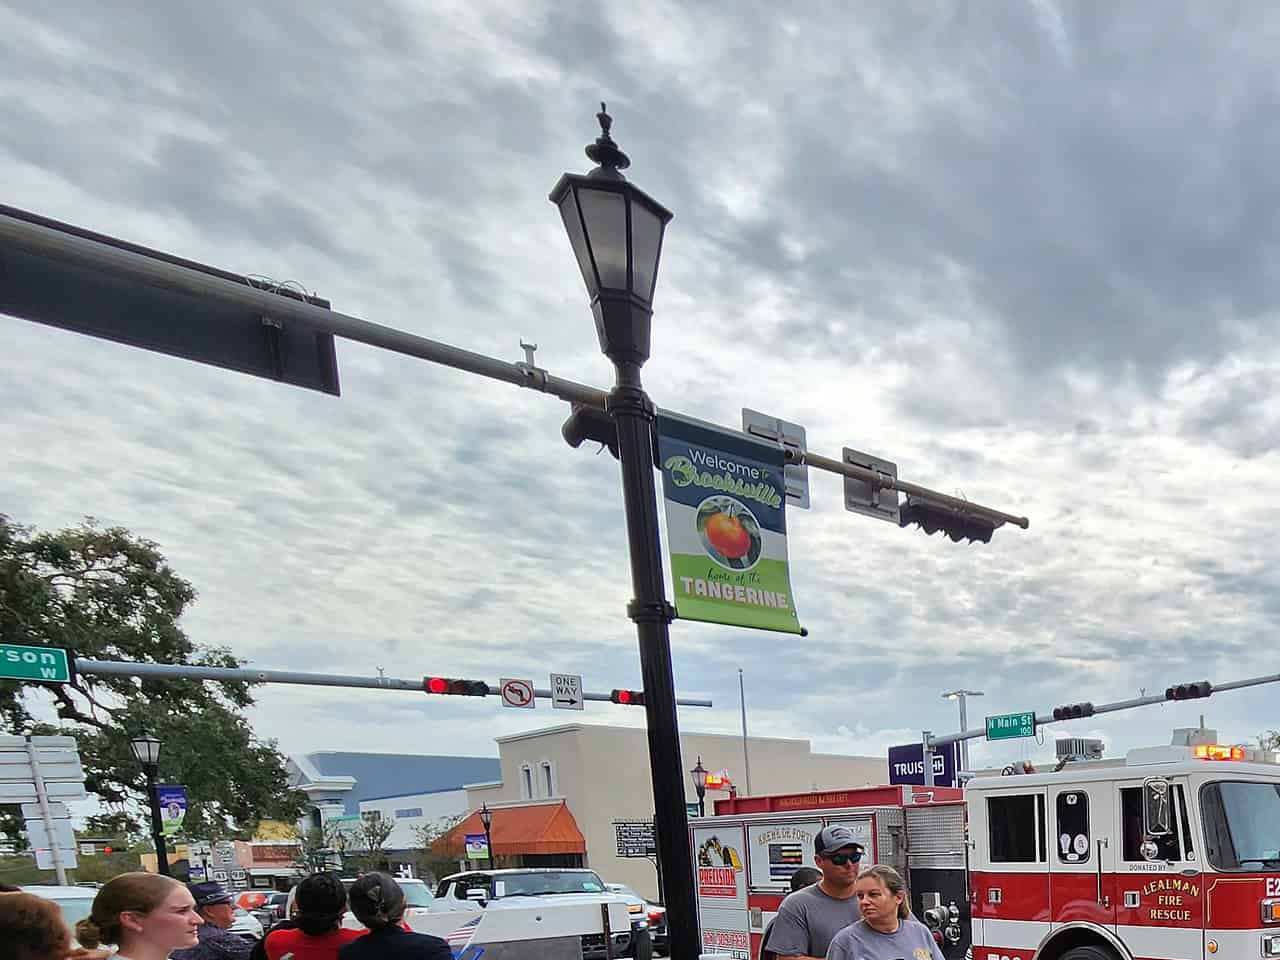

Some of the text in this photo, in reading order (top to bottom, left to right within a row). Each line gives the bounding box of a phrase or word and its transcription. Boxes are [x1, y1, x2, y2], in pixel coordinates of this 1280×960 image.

[688, 448, 760, 479] Welcome
[664, 455, 782, 509] Brooksville
[679, 575, 789, 610] TANGERINE
[40, 667, 57, 679] W
[555, 676, 577, 687] ONE
[556, 686, 578, 696] WAY
[997, 717, 1018, 729] Main
[1021, 715, 1032, 726] St
[1020, 727, 1032, 737] 100
[893, 761, 924, 776] TRUIS
[1129, 864, 1157, 872] DONATED
[1143, 879, 1200, 897] LEALMAN
[1158, 895, 1184, 906] FIRE
[1150, 909, 1192, 921] RESCUE
